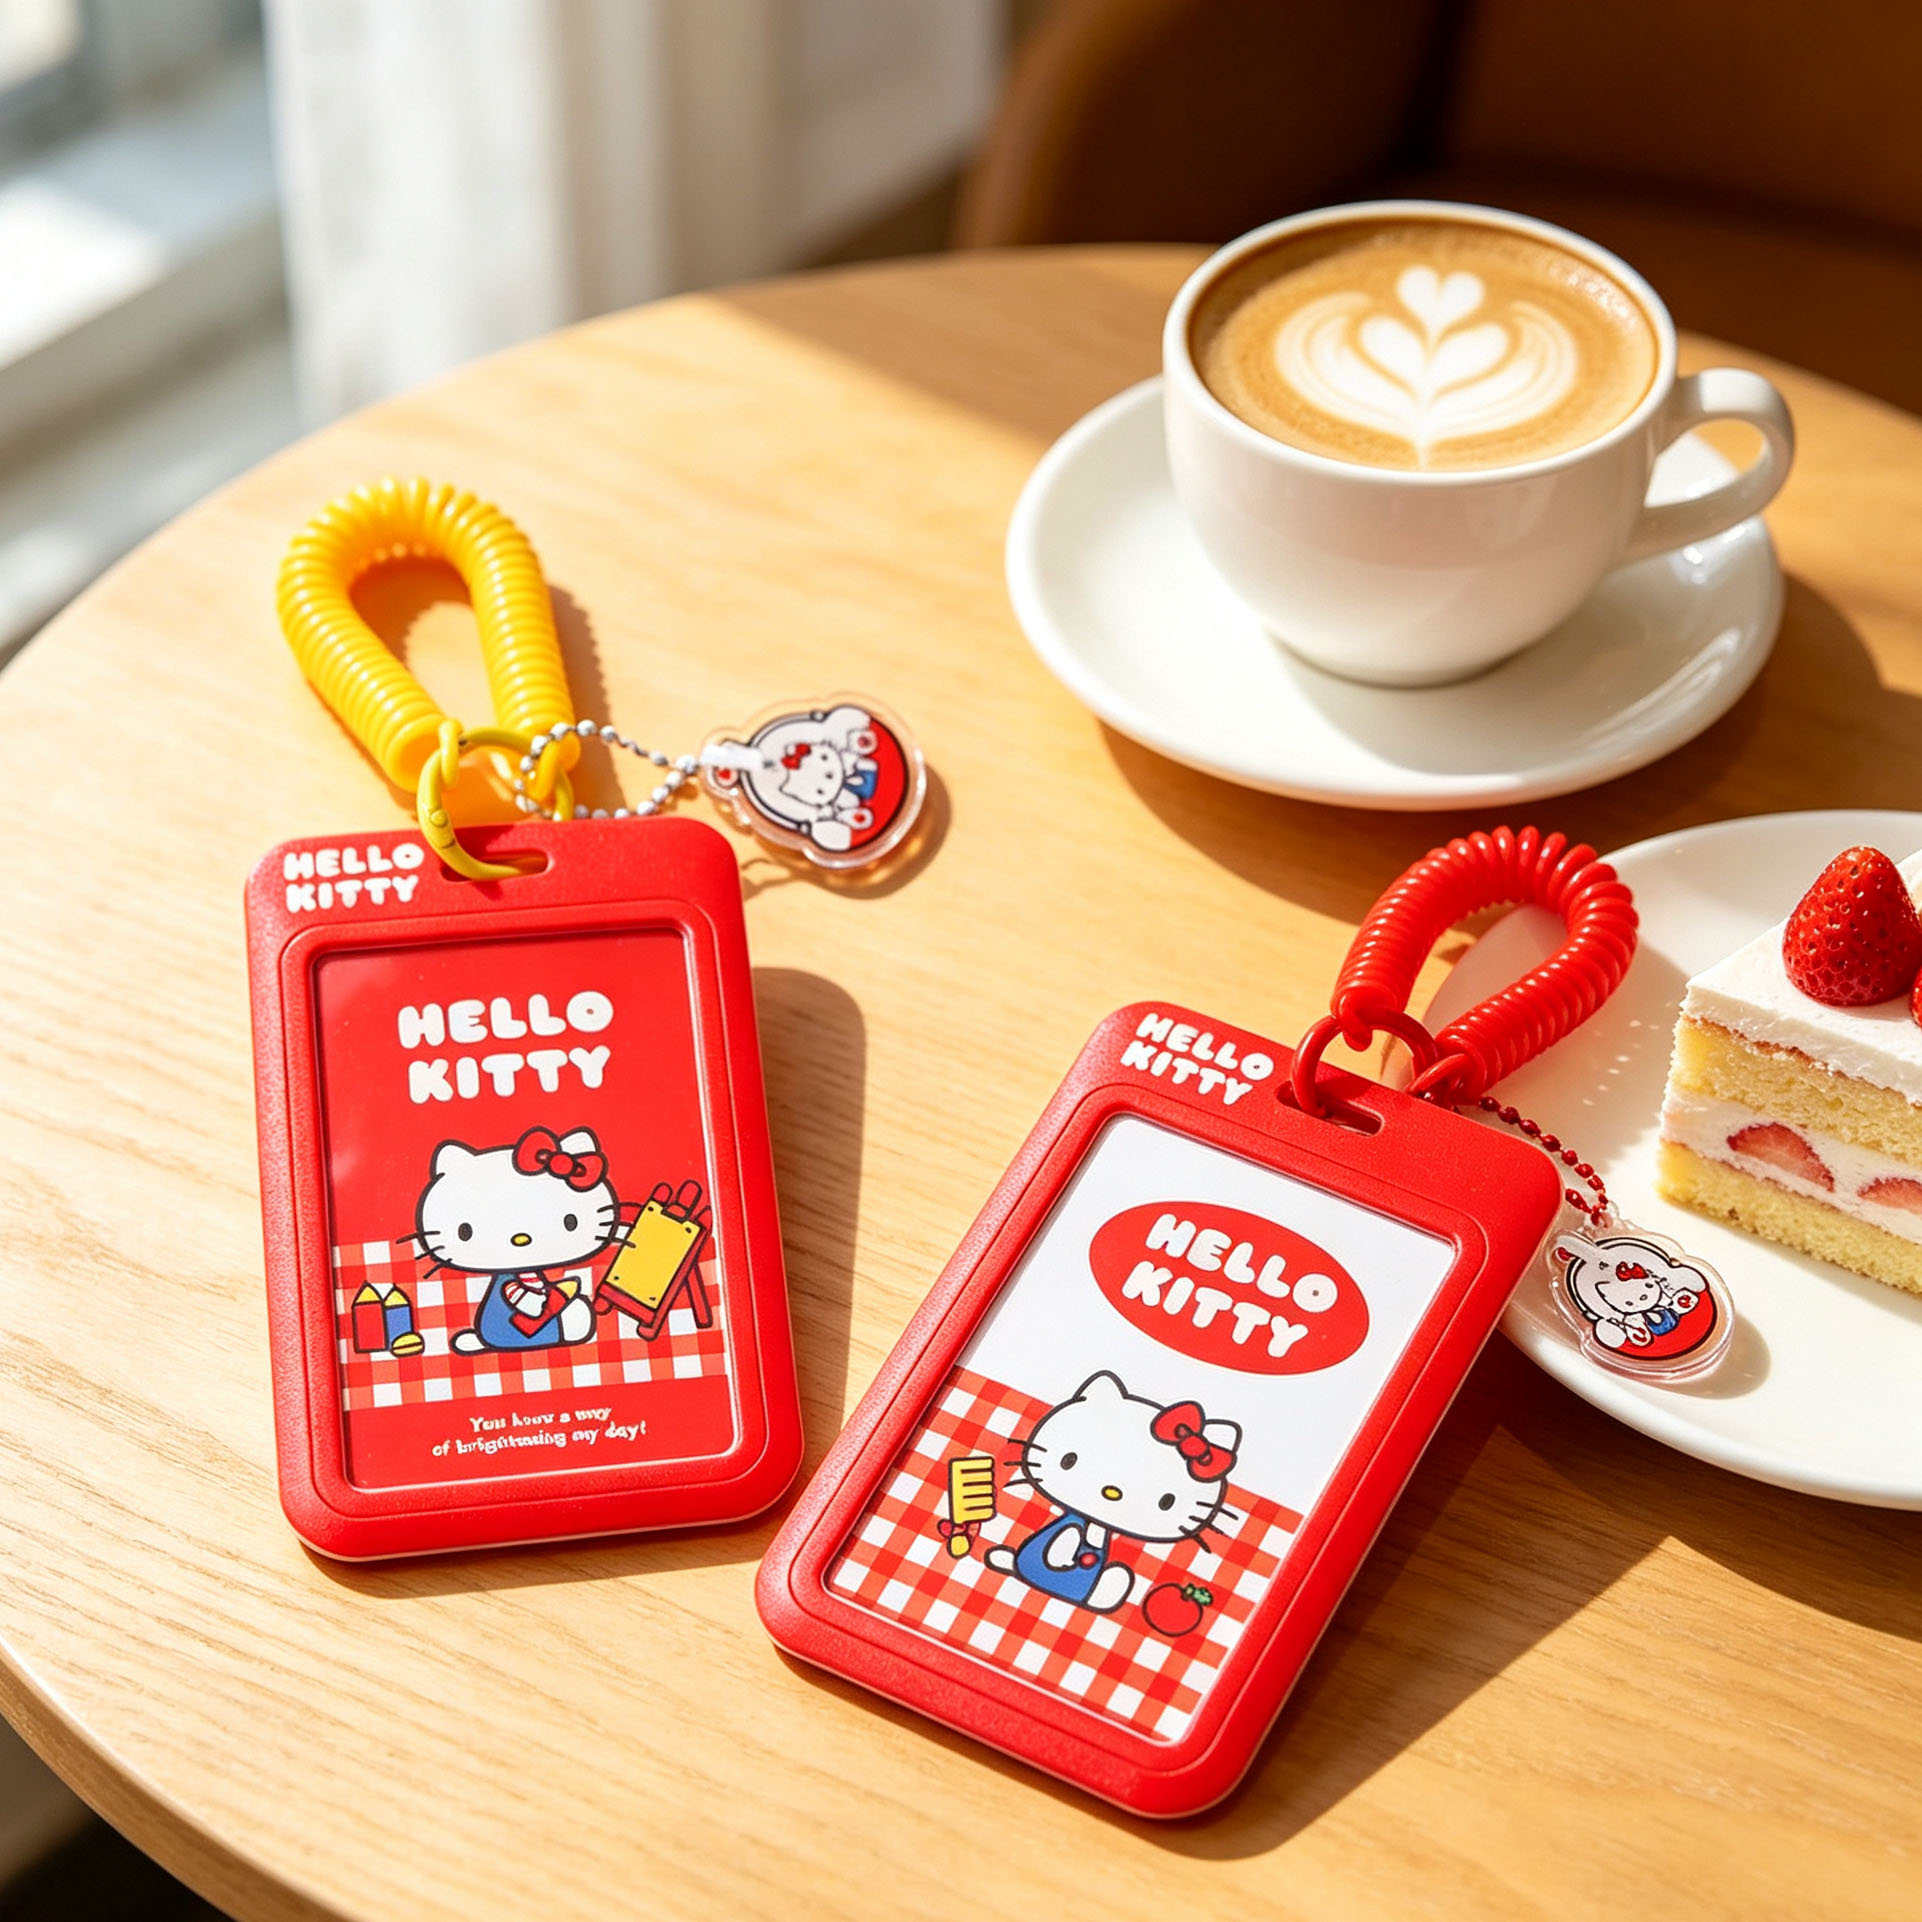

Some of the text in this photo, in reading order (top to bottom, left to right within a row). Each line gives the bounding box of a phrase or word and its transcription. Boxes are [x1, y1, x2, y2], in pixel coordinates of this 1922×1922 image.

[283, 842, 425, 880] HELLO
[286, 875, 419, 914] KITTY
[397, 991, 614, 1048] HELLO
[1136, 1013, 1274, 1081] HELLO
[408, 1045, 611, 1103] KITTY
[1119, 1039, 1253, 1105] KITTY
[1146, 1213, 1338, 1313] HELLO
[1121, 1260, 1309, 1358] KITTY
[431, 1439, 451, 1457] of
